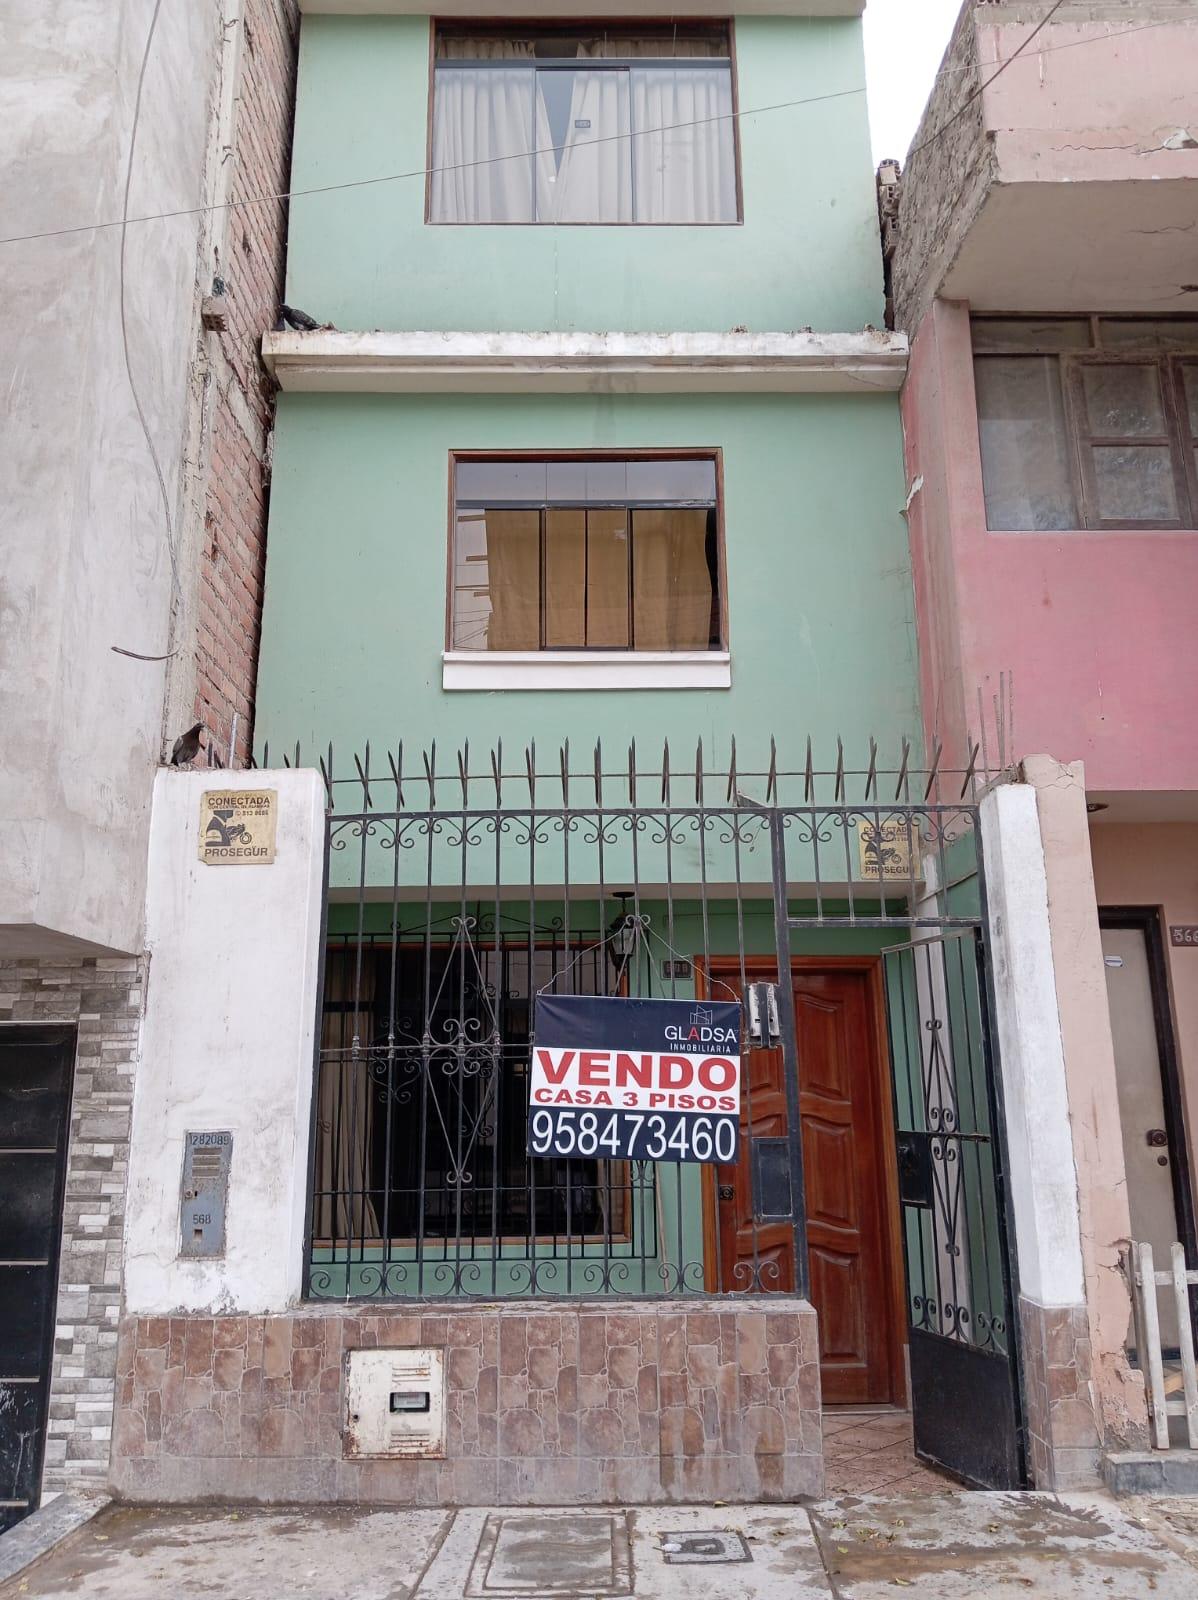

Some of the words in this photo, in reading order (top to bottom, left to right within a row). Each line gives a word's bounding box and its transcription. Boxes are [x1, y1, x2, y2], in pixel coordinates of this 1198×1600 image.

[208, 797, 270, 806] CONECTADA
[204, 847, 268, 857] PROSEGUR
[664, 1025, 738, 1043] GLADSA
[670, 1043, 731, 1053] INMOBILIARIA
[536, 1050, 737, 1092] VENDO
[534, 1088, 613, 1106] CASA
[622, 1091, 639, 1107] 3
[649, 1093, 736, 1111] PISOS
[532, 1110, 736, 1161] 958473460
[192, 1214, 212, 1225] 568
